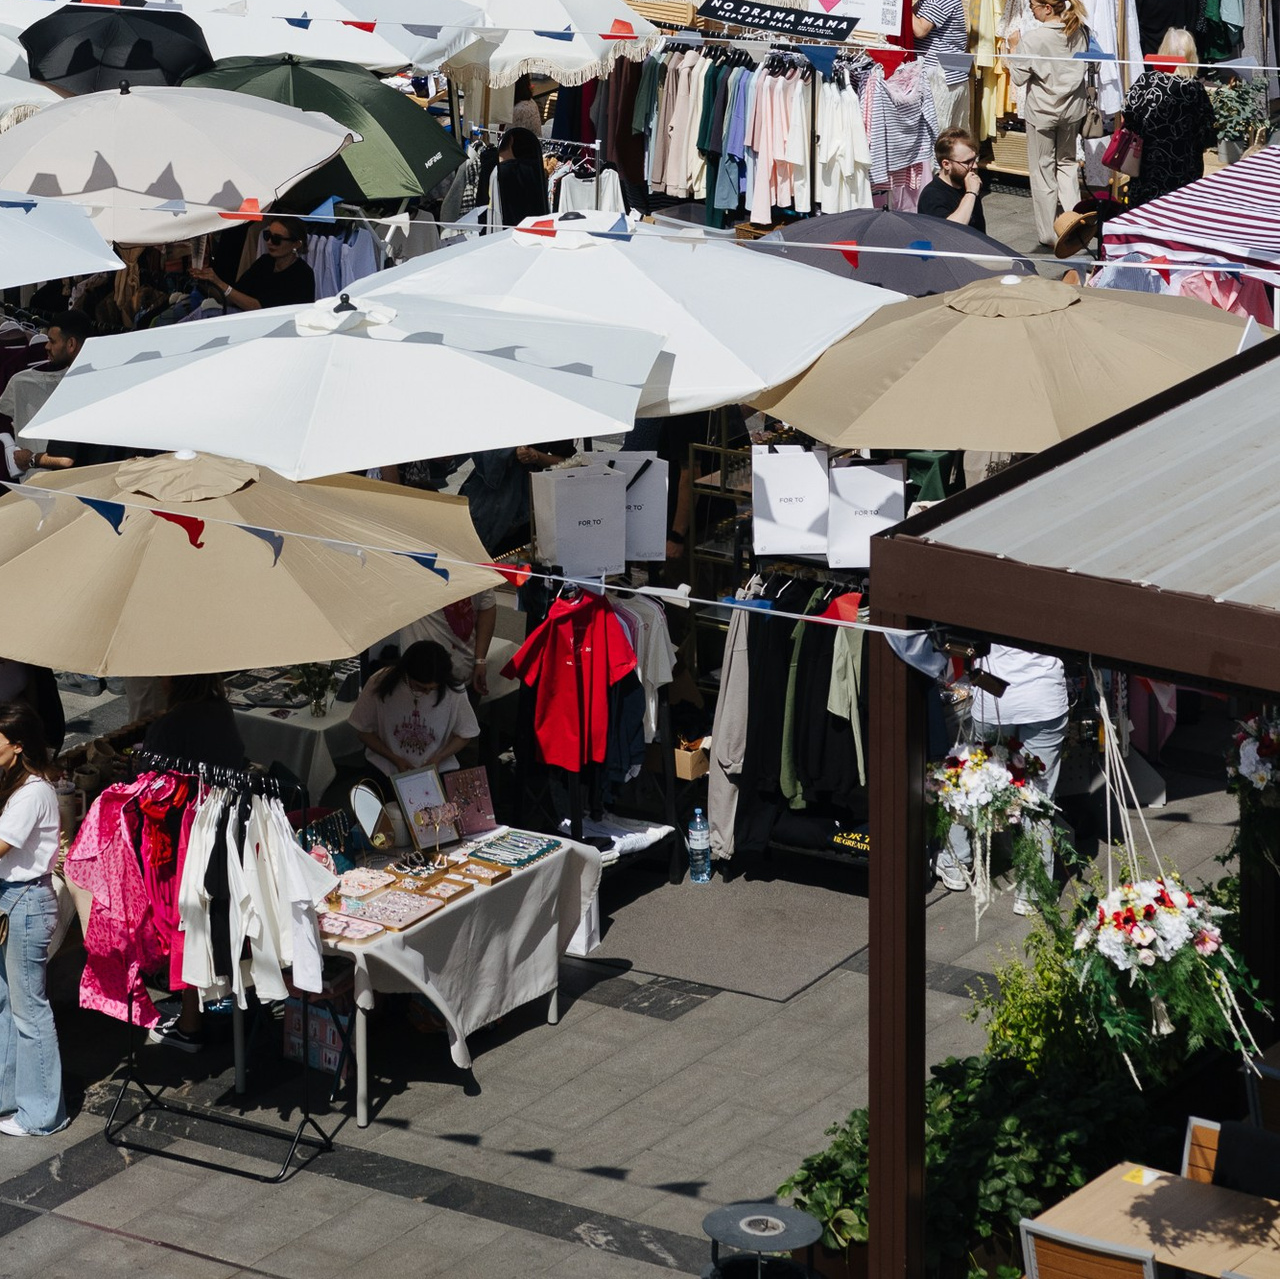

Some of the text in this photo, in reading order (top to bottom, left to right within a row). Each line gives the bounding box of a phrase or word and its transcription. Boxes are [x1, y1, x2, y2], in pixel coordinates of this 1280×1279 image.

[717, 10, 743, 20] МЕРЧ
[745, 16, 765, 25] ДЛЯ
[740, 5, 795, 22] DRAMA
[802, 15, 848, 30] MAMA
